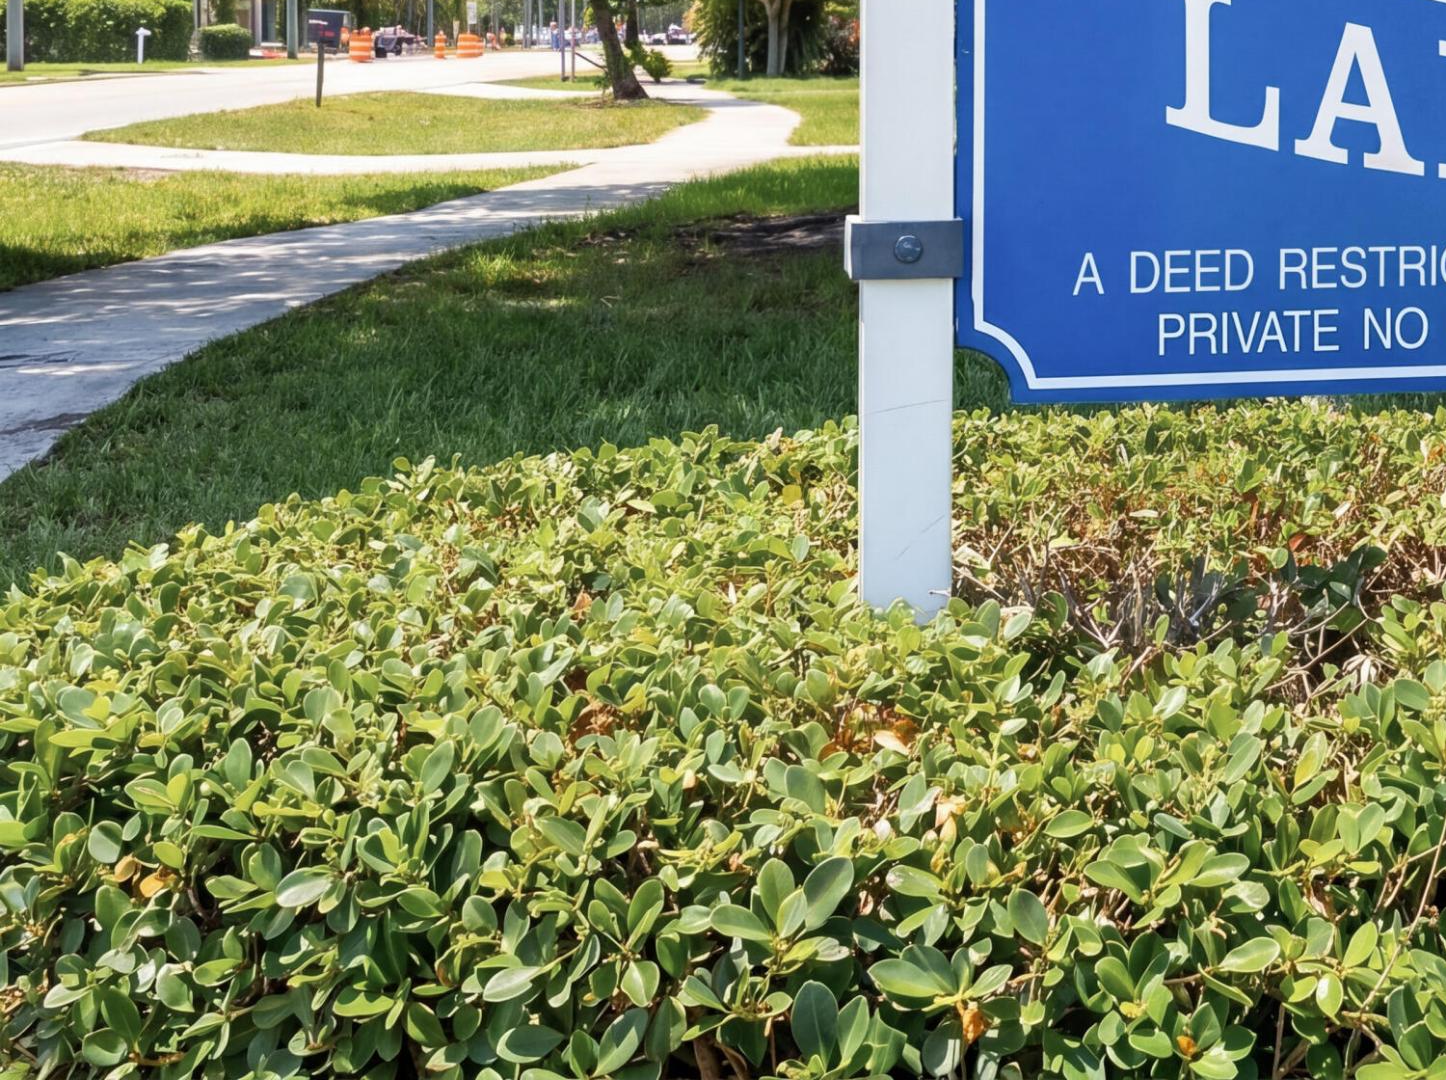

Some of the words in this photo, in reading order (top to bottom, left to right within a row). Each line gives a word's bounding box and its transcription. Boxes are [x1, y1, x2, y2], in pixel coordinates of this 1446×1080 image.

[1072, 252, 1105, 296] A
[1129, 247, 1255, 294] DEED
[1158, 308, 1340, 356] PRIVATE
[1363, 306, 1429, 350] NO
